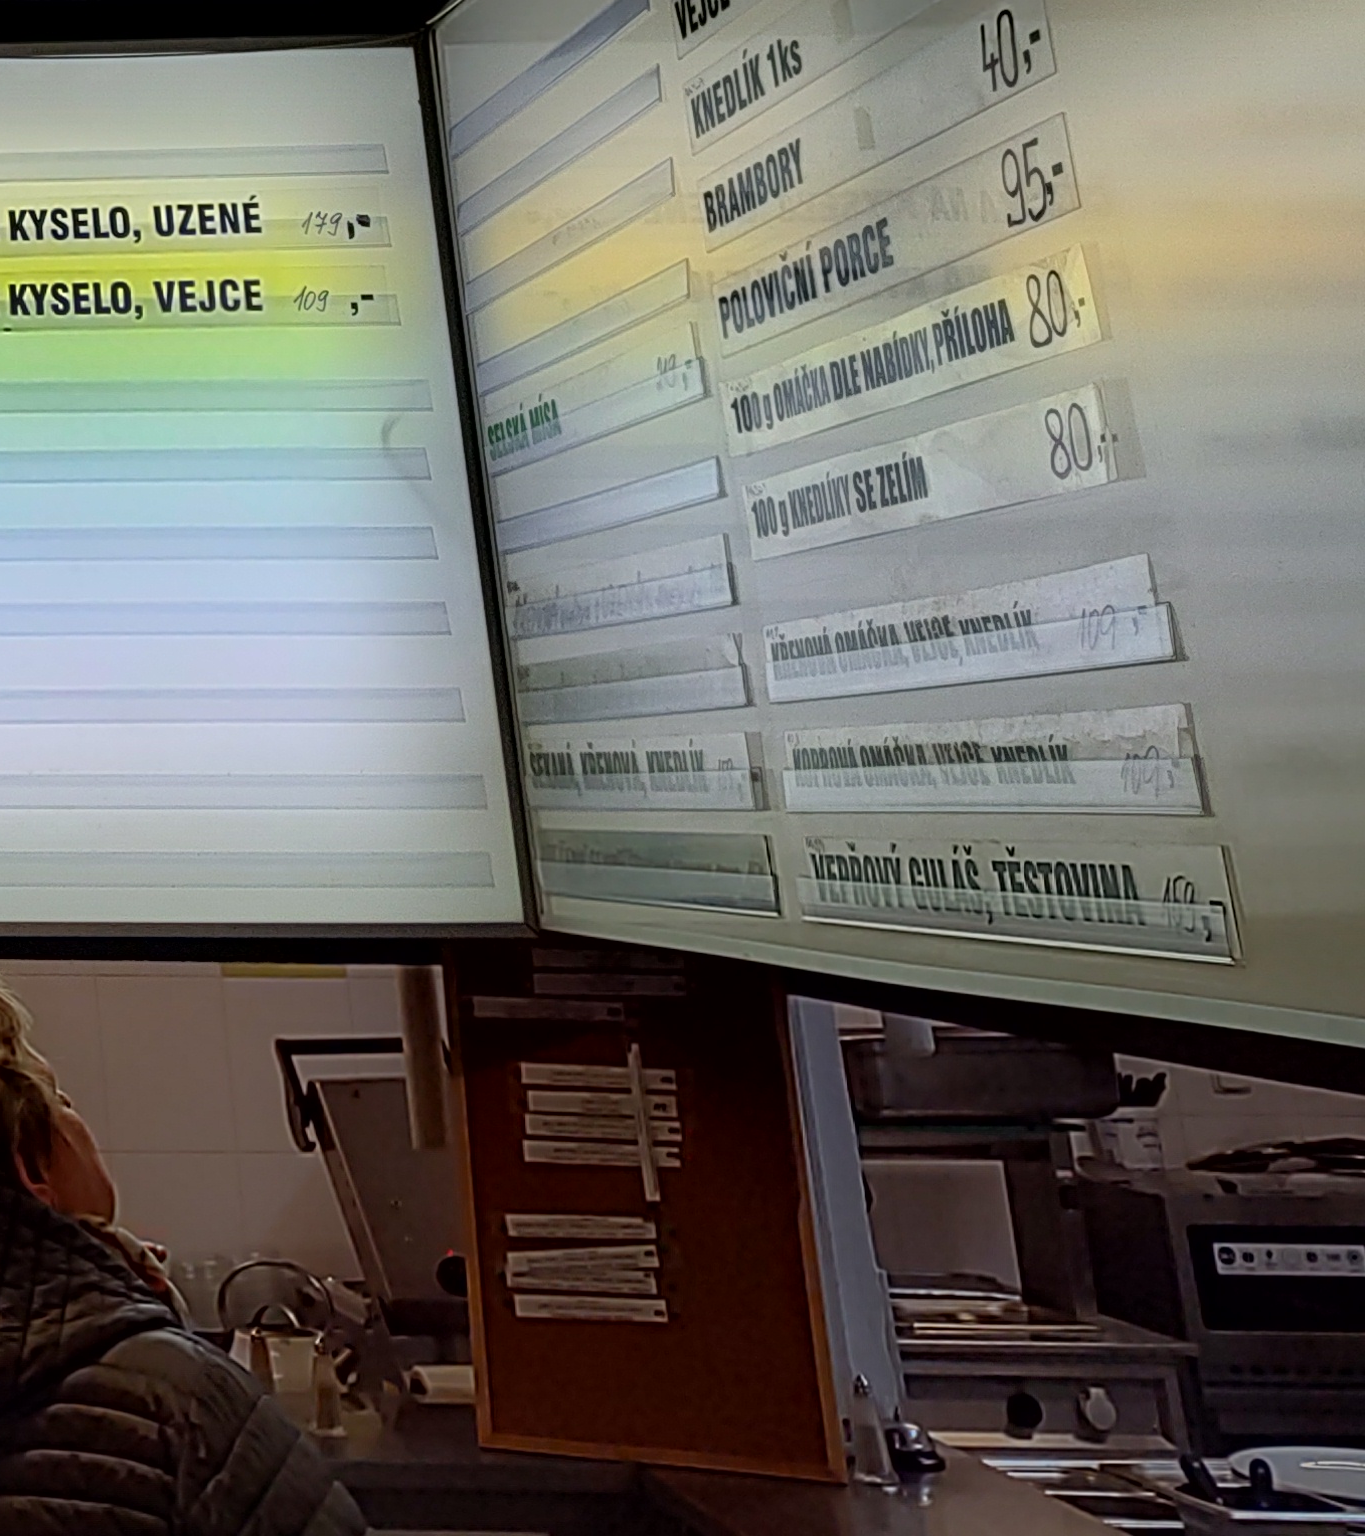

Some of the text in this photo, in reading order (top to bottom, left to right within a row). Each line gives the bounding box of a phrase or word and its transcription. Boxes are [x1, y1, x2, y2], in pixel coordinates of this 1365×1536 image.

[691, 48, 766, 139] KNEDLÍK
[767, 39, 803, 90] 1ks
[703, 9, 1041, 234] BRAMBORY 40,-
[8, 206, 142, 244] KYSELO,
[153, 195, 263, 237] UZENÉ
[717, 137, 1064, 340] POLOVIČNÍ PORCE 95,-
[8, 280, 144, 320] KYSELO,
[155, 279, 264, 312] VEJCE
[731, 392, 762, 434] 100
[764, 389, 774, 429] g
[774, 364, 830, 424] OMÁČKA
[830, 352, 862, 401] DLE
[862, 331, 935, 391] NABÍDKY,
[935, 298, 1015, 366] PŘÍLOHA
[751, 494, 777, 539] 100
[780, 500, 789, 537] g
[787, 466, 853, 530] KNEDLÍKY
[853, 469, 878, 514] SE
[879, 452, 928, 506] ZELÍM
[992, 846, 1146, 925] TĚSTOVINA
